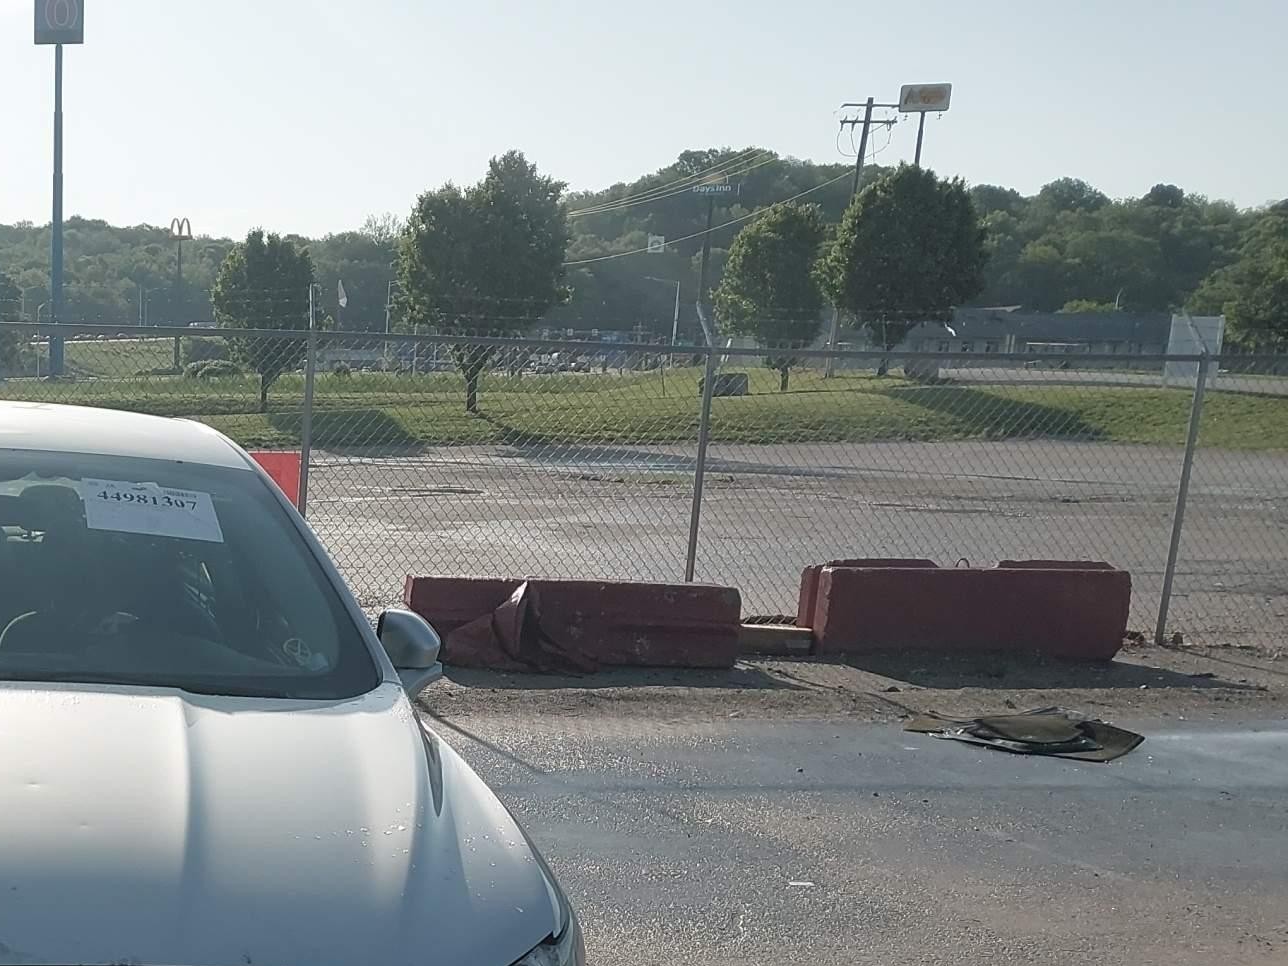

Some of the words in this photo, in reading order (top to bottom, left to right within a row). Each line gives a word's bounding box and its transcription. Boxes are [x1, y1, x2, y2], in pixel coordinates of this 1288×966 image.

[692, 185, 714, 193] Days
[715, 184, 732, 192] Inn
[96, 490, 198, 511] 44981307
